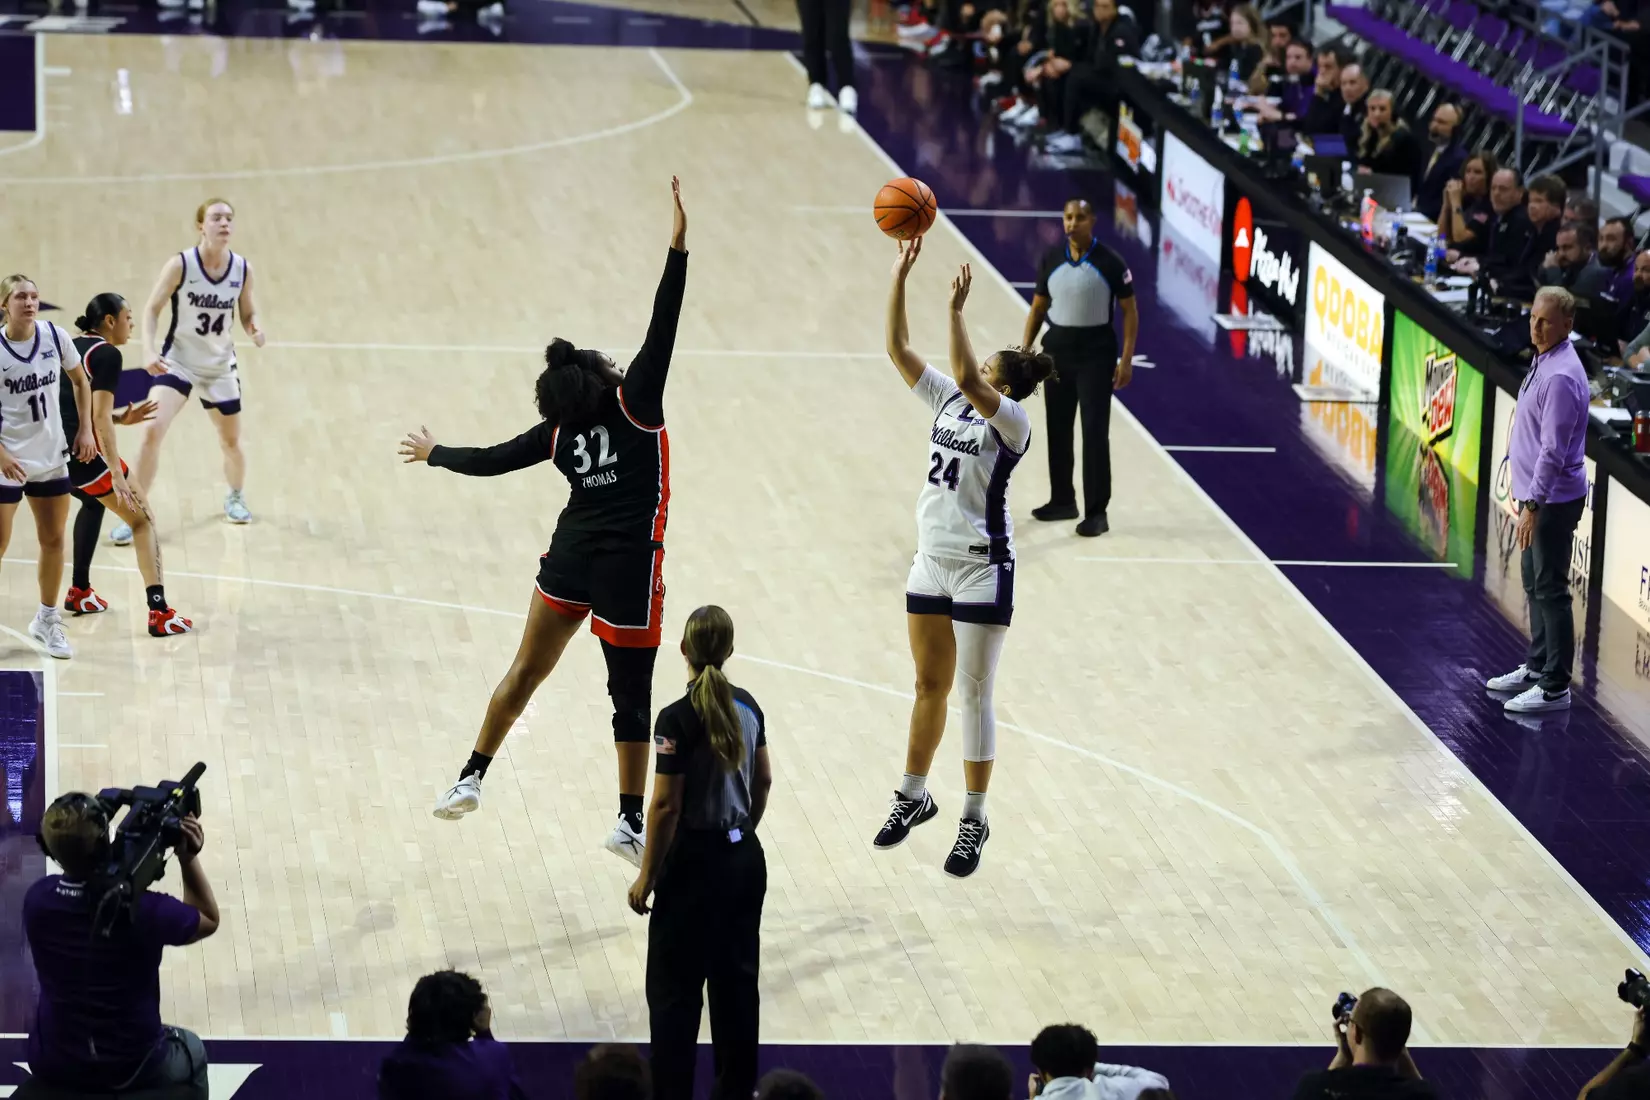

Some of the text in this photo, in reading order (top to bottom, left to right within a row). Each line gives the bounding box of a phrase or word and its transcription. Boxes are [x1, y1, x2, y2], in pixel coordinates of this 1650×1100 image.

[195, 312, 226, 337] 34
[1313, 264, 1383, 364] QDOBA
[4, 369, 57, 395] Wildcats
[26, 393, 49, 422] 11
[573, 425, 618, 474] 32
[931, 425, 980, 456] Wildcats
[582, 470, 617, 488] THOMAS
[928, 451, 961, 492] 24
